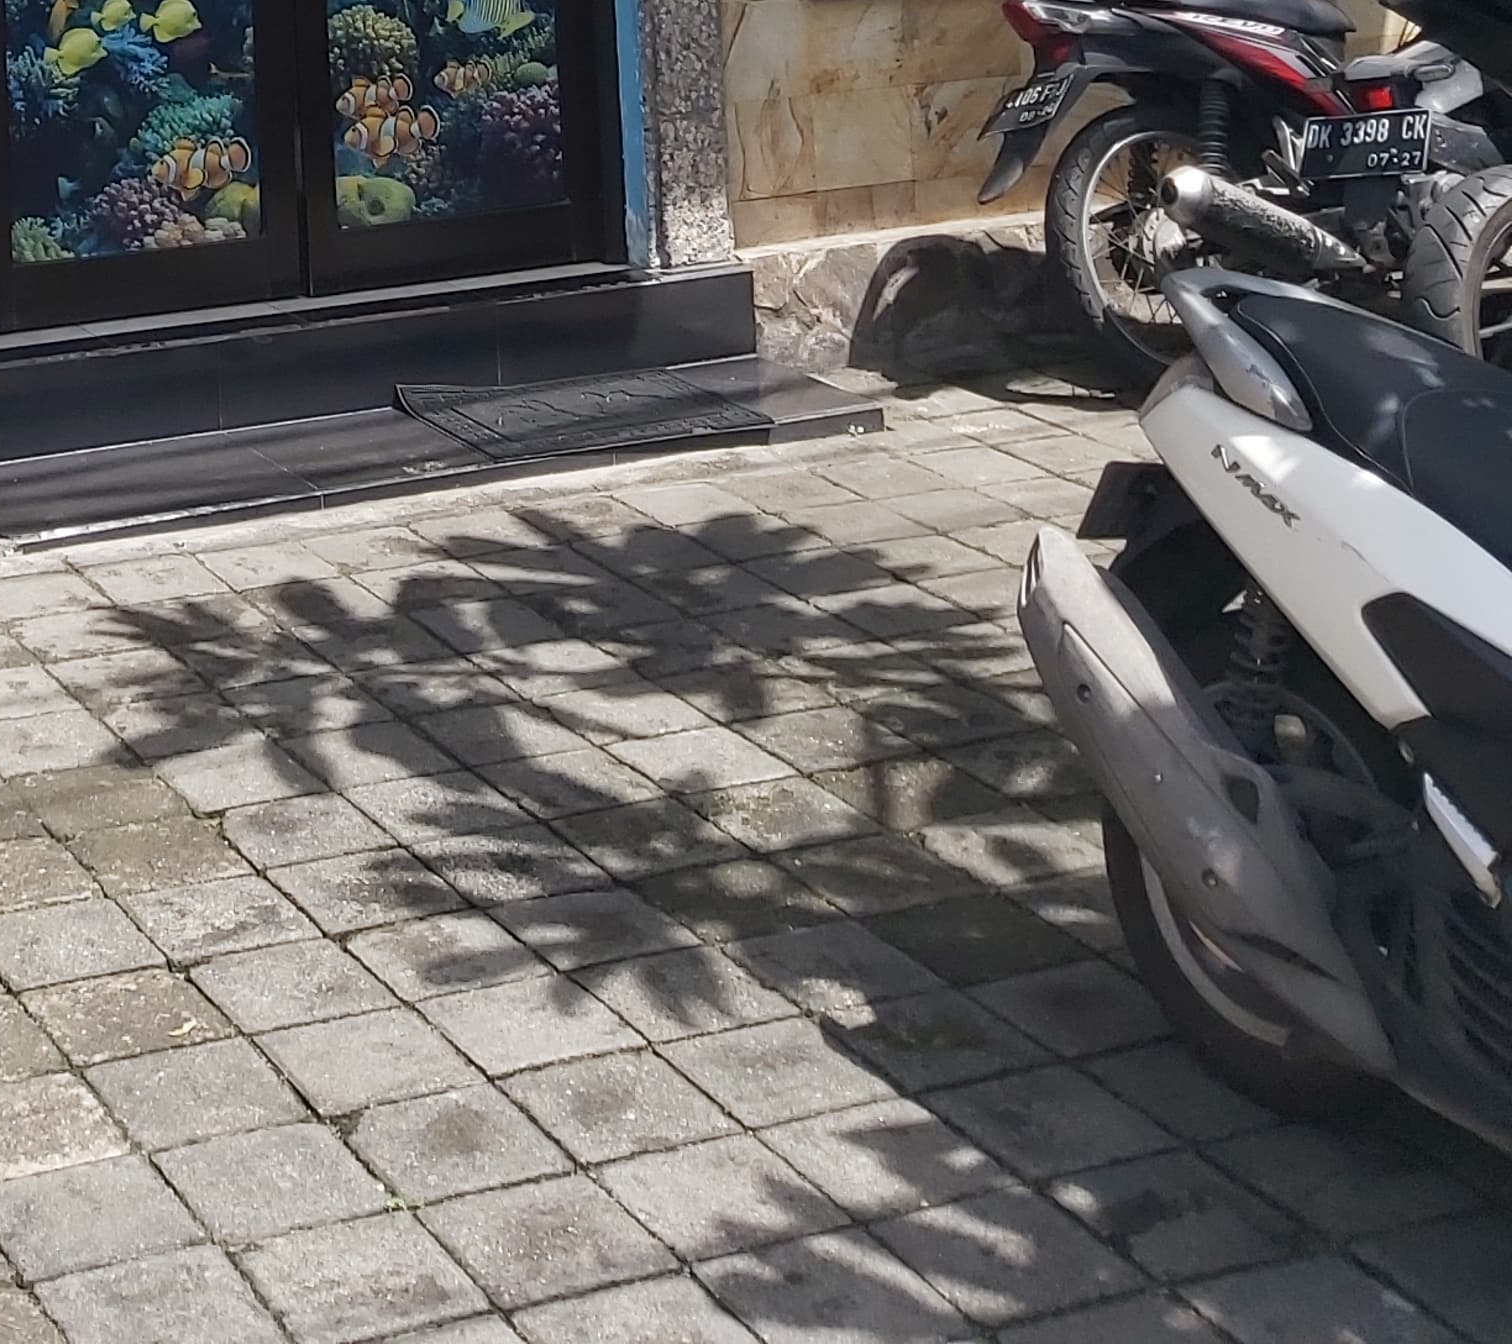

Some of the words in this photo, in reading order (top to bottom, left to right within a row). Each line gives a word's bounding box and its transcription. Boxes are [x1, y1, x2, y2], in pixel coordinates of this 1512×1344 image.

[1307, 123, 1332, 149] DK
[1340, 118, 1390, 146] 3398
[1401, 114, 1427, 140] CK
